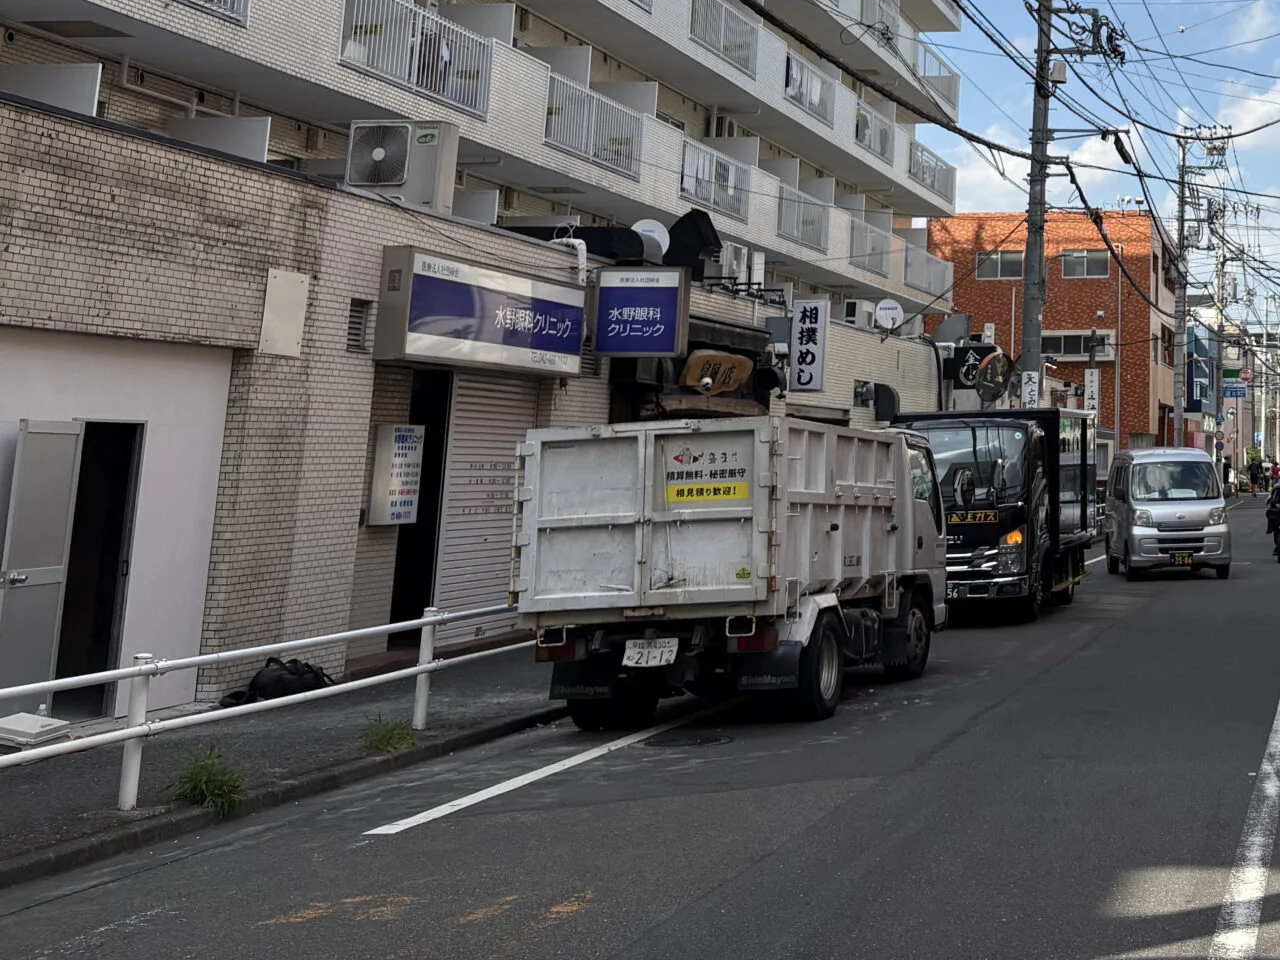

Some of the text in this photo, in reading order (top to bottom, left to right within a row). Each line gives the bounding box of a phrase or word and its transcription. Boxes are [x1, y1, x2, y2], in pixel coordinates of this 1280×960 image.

[494, 305, 572, 338] 水野眼科クリニック
[608, 306, 661, 321] 水野眼科
[607, 323, 665, 337] クリニック
[796, 305, 819, 386] 相撲めし
